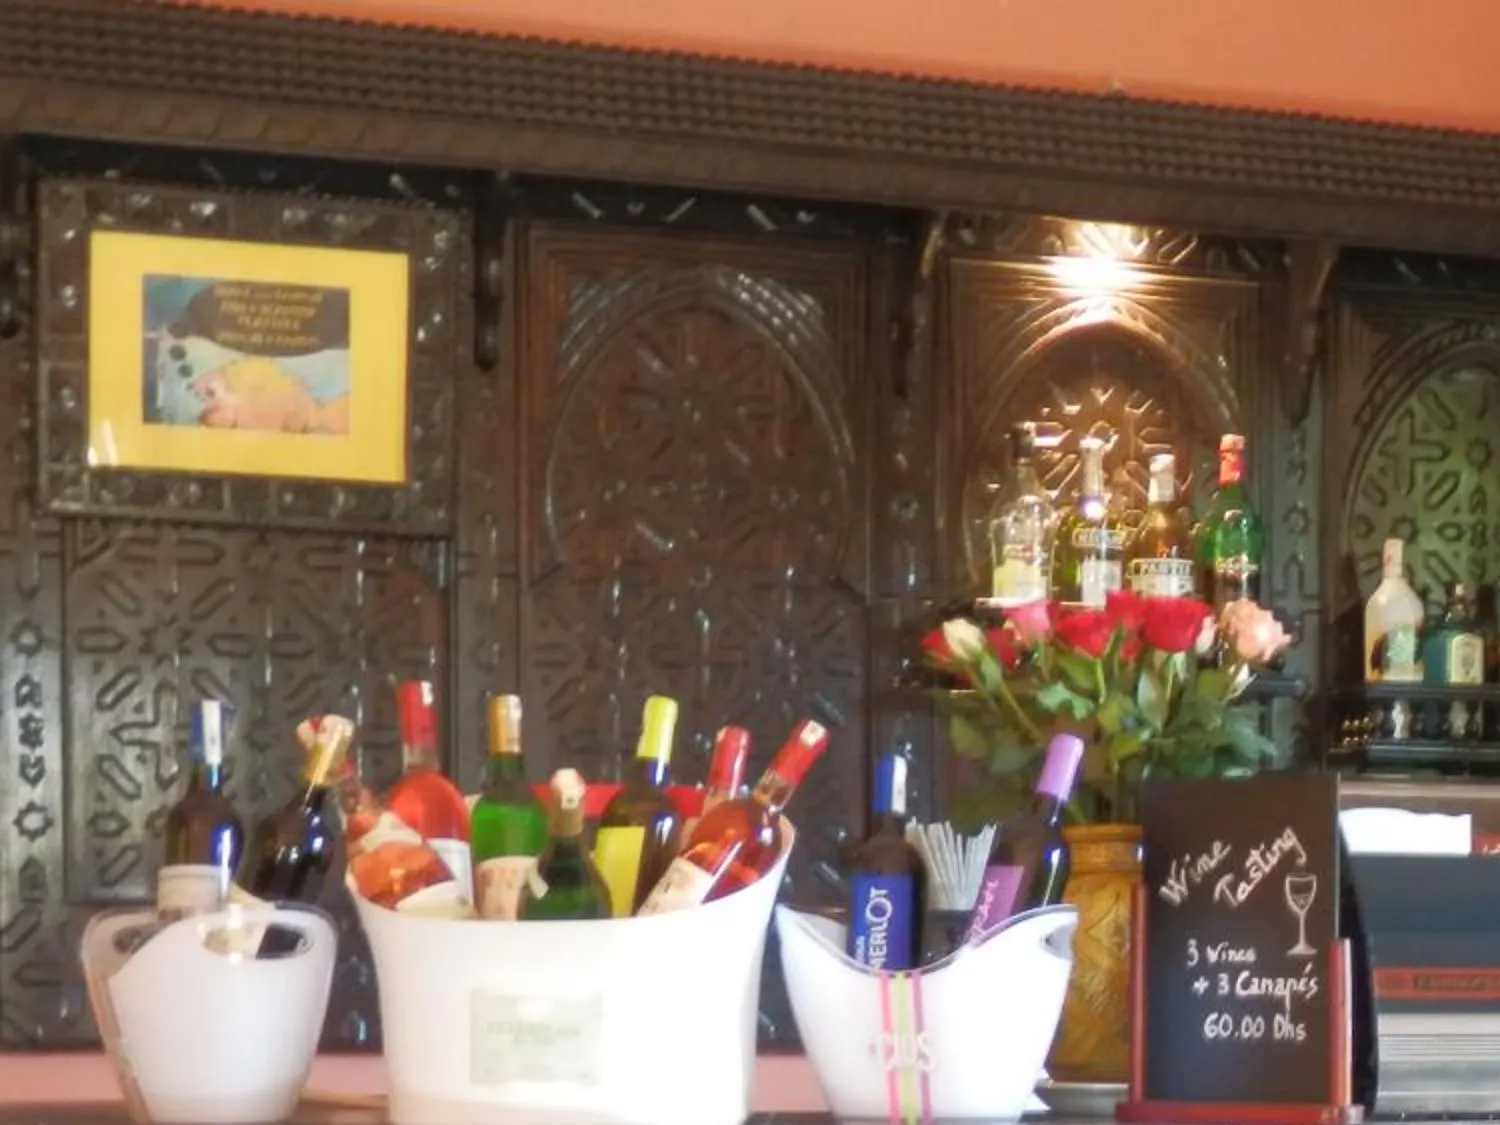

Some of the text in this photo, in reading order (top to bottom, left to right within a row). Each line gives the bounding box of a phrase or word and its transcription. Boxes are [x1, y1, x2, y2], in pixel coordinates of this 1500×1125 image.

[1158, 840, 1232, 906] Wine
[1214, 826, 1308, 908] Tasting
[1187, 938, 1199, 967] 3
[1217, 973, 1229, 995] 3
[1203, 1012, 1307, 1041] 60.00 Dhs
